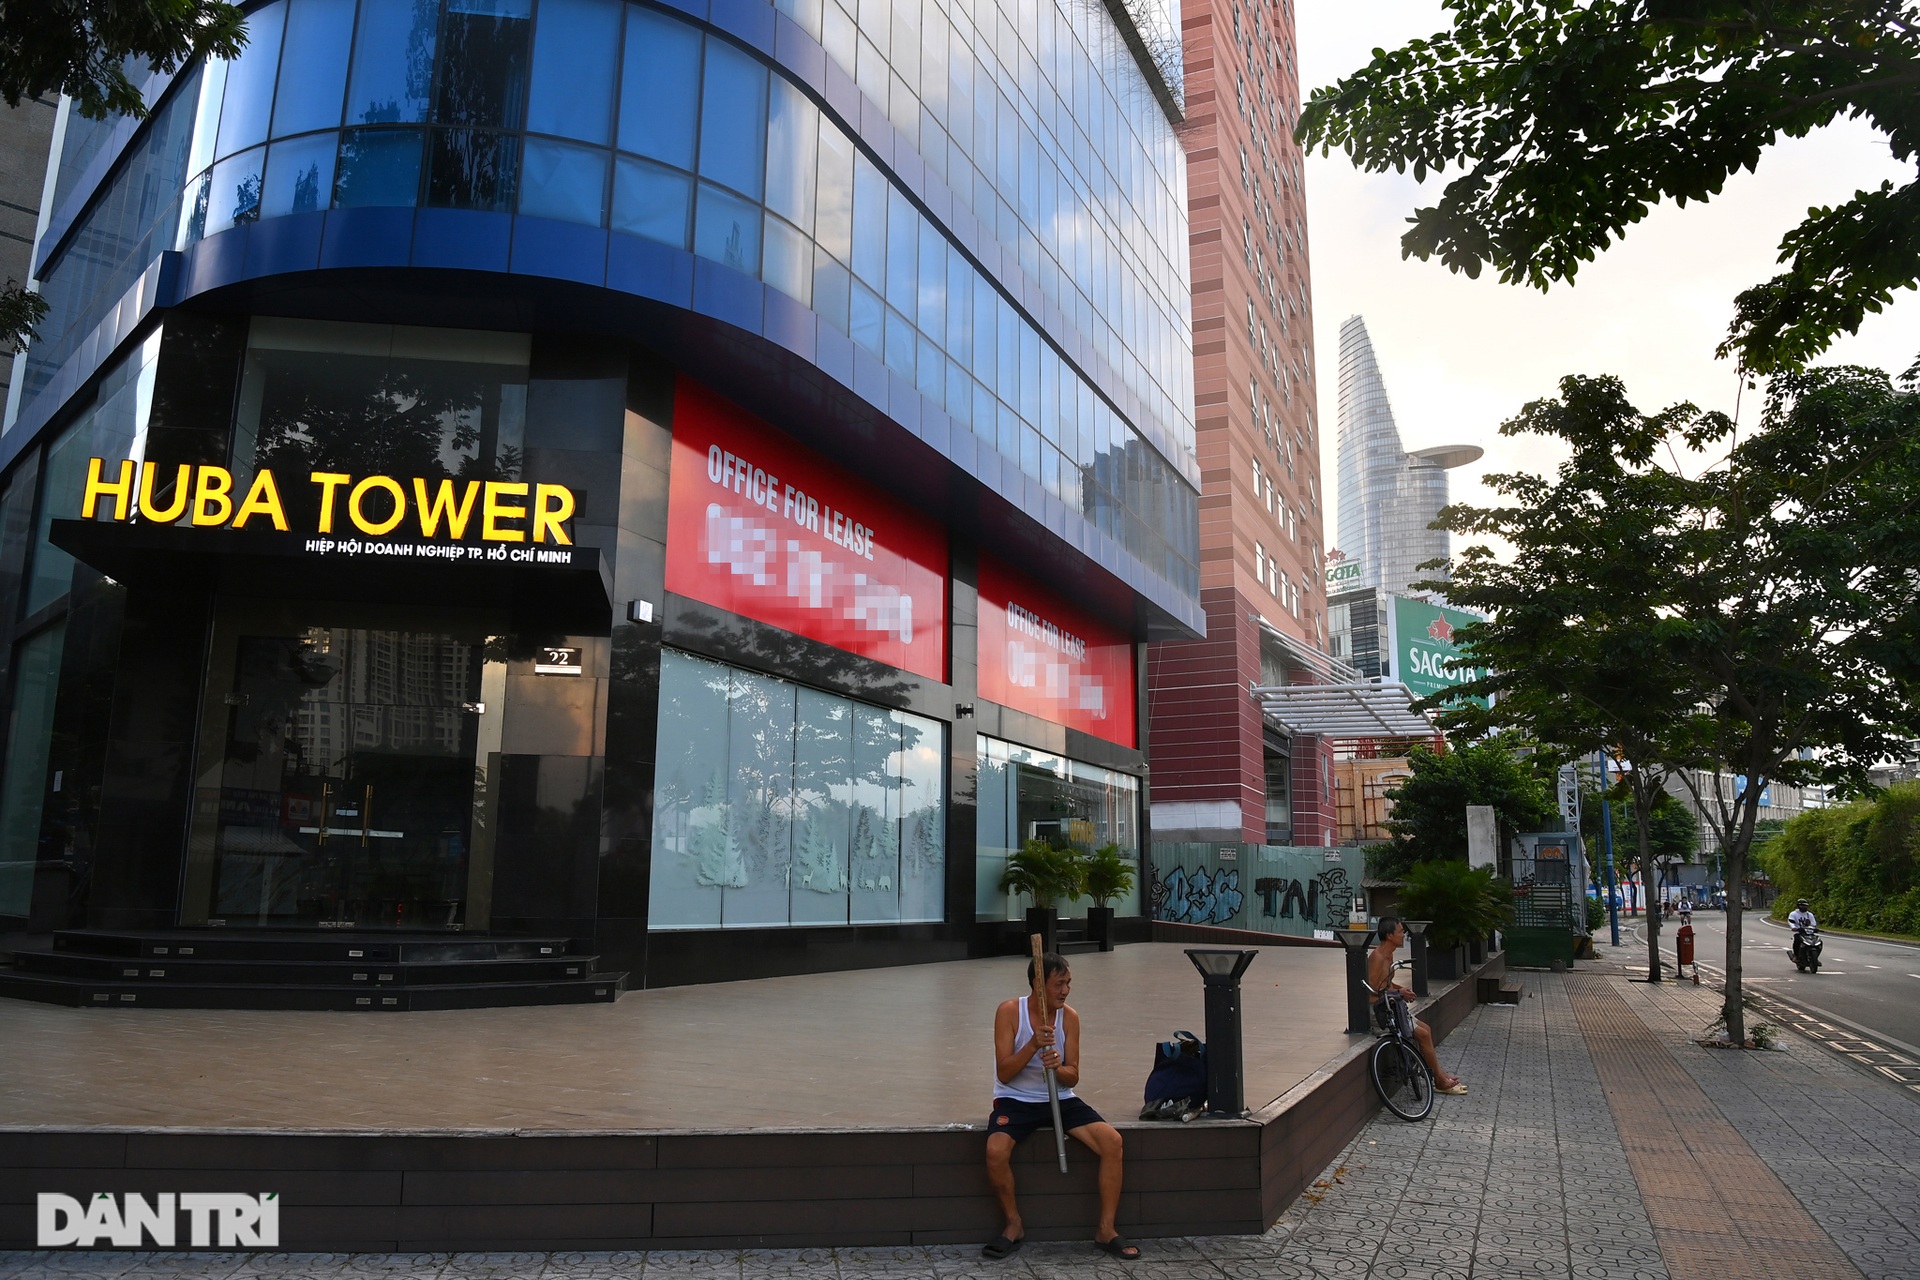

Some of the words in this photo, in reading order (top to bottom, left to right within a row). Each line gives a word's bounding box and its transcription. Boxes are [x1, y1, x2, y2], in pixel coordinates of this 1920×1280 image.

[80, 457, 291, 532] HUBA
[311, 472, 576, 546] TOWER
[707, 444, 779, 513] OFFICE
[783, 483, 819, 534] FOR
[823, 505, 874, 562] LEASE
[305, 537, 335, 556] HIỆP
[337, 538, 362, 557] HỘI
[366, 541, 413, 556] DOANH
[415, 543, 465, 562] NGHIỆP
[467, 547, 484, 560] TP.
[510, 549, 534, 563] CHÍ
[537, 551, 572, 564] MINH
[1007, 600, 1040, 641] OFFICE
[1042, 618, 1059, 650] FOR
[1060, 629, 1086, 663] LEASE
